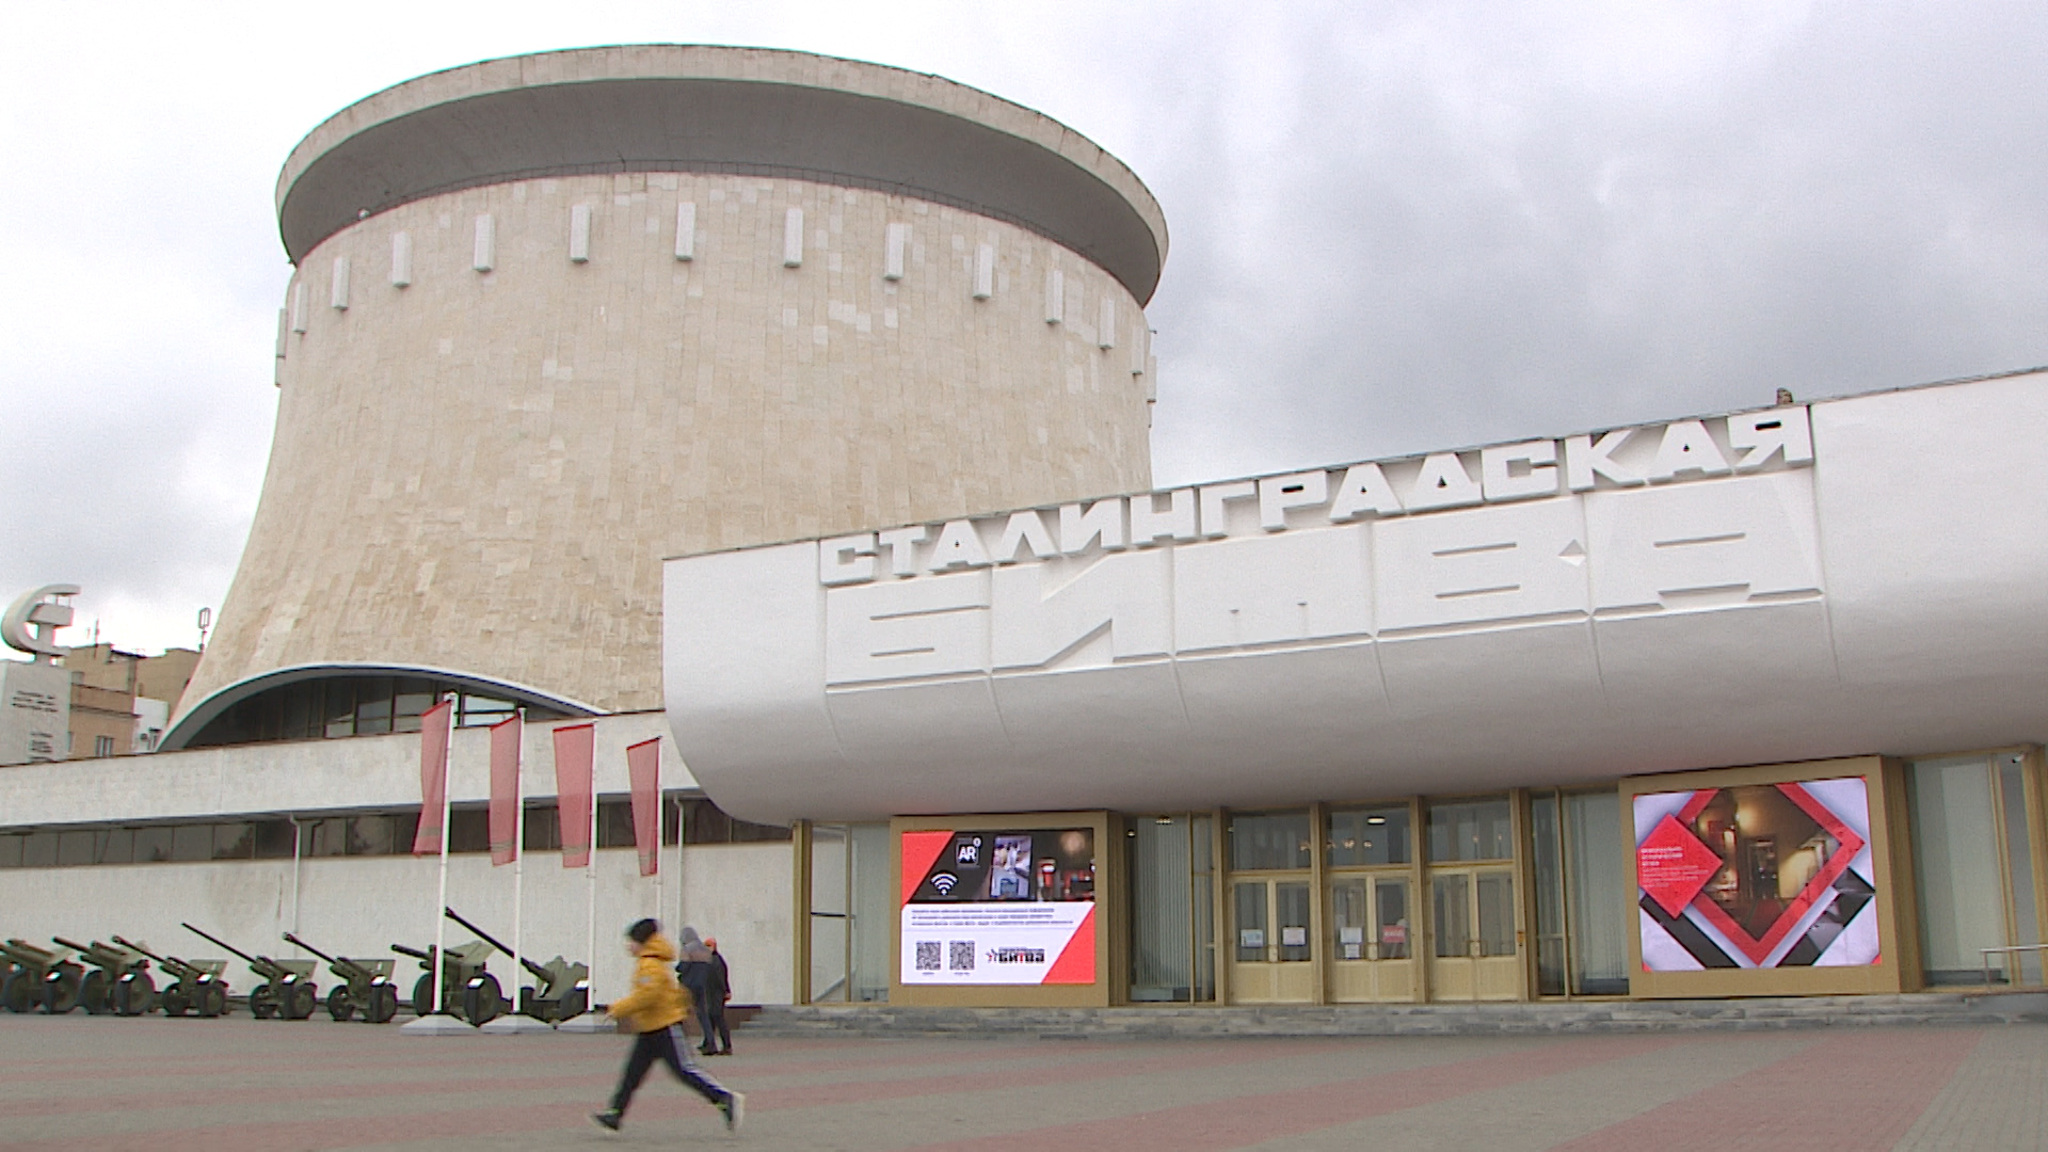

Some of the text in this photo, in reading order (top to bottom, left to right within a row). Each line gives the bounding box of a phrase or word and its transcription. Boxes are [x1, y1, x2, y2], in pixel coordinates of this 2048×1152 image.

[820, 404, 1814, 586] СТАЛИНГРАДСКАЯ
[826, 466, 1824, 691] БИТВА
[958, 845, 977, 860] AR
